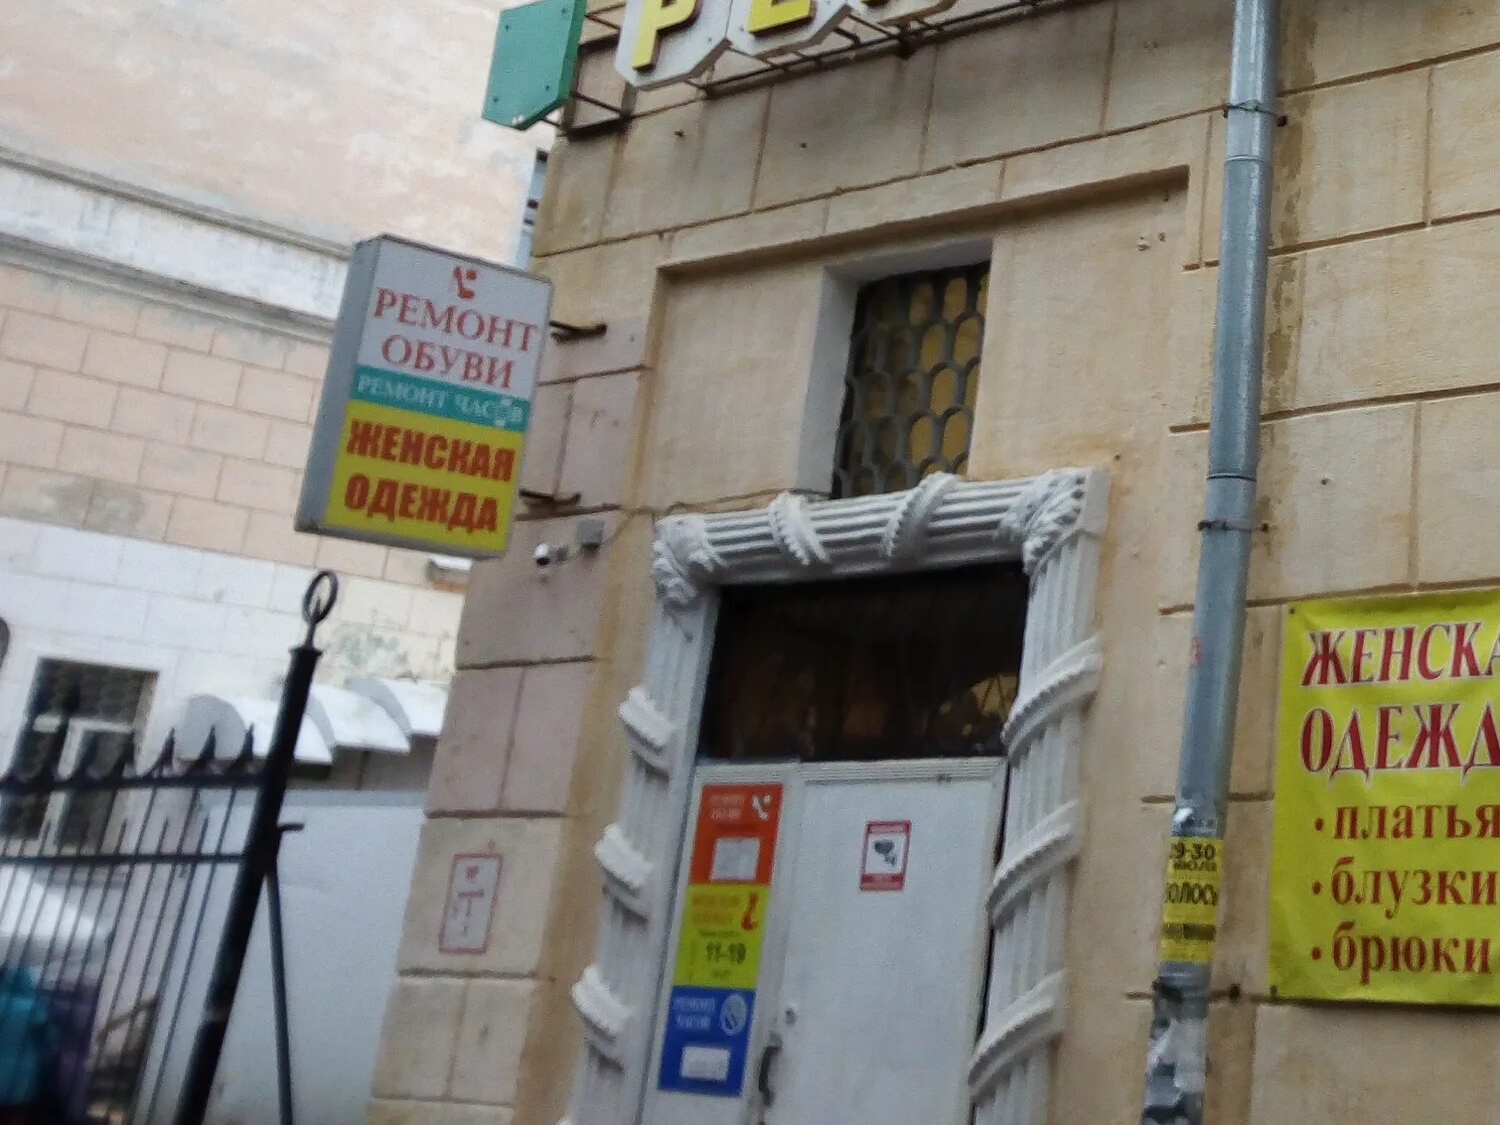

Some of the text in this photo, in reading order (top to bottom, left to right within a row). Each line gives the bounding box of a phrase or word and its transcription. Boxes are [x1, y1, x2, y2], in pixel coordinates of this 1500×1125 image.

[374, 287, 537, 352] РЕМОНТ
[358, 375, 448, 409] РЕМОНТ
[381, 334, 516, 389] ОБУВИ
[346, 419, 515, 483] ЖЕНСКАЯ
[344, 472, 499, 536] ОДЕЖДА
[1331, 856, 1498, 919] блузки
[1332, 921, 1492, 985] брюки
